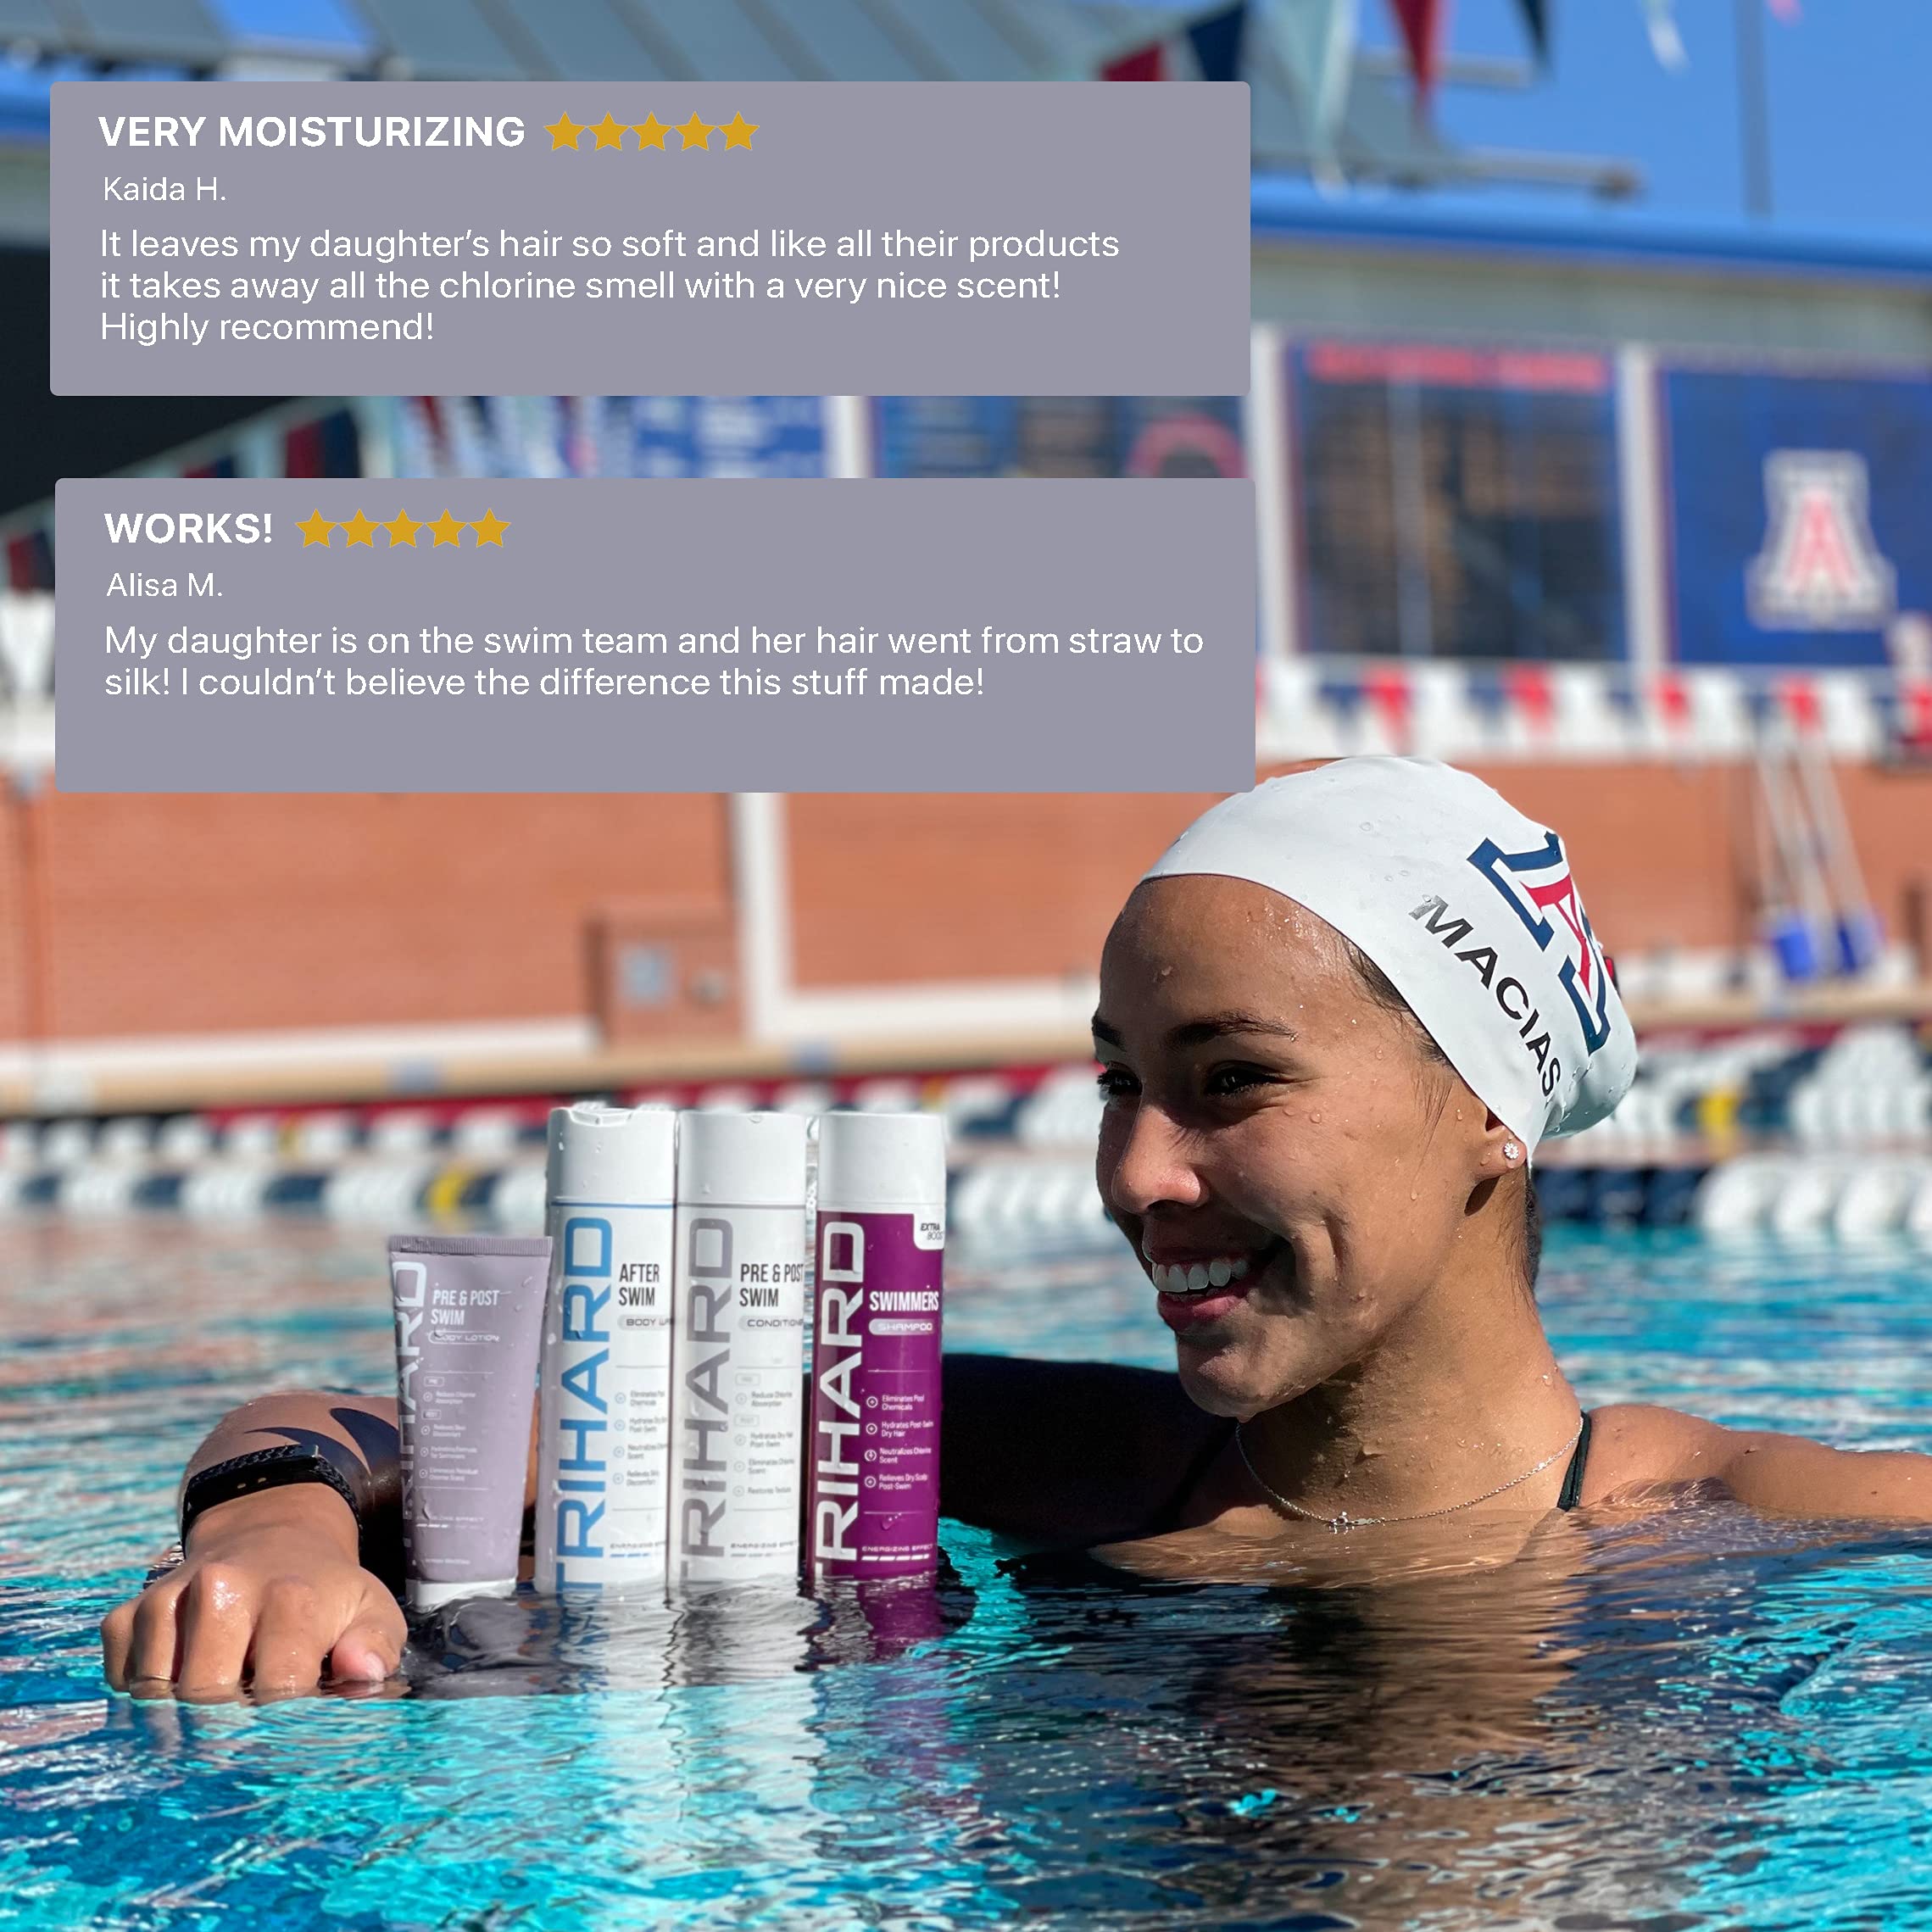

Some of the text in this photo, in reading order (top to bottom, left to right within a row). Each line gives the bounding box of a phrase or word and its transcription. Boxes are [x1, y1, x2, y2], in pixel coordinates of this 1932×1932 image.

[1408, 894, 1561, 1097] MACIAS
[921, 1222, 940, 1231] EXTRA
[619, 1263, 660, 1283] AFTER
[740, 1263, 769, 1283] PRE
[772, 1263, 780, 1283] &
[432, 1289, 500, 1306] PRE & POST
[618, 1287, 655, 1307] SWIM
[739, 1288, 779, 1307] SWIM
[869, 1290, 939, 1311] SWIMMERS
[431, 1308, 465, 1326] SWIM
[626, 1318, 656, 1327] BODY
[877, 1322, 933, 1332] SHAMPOO
